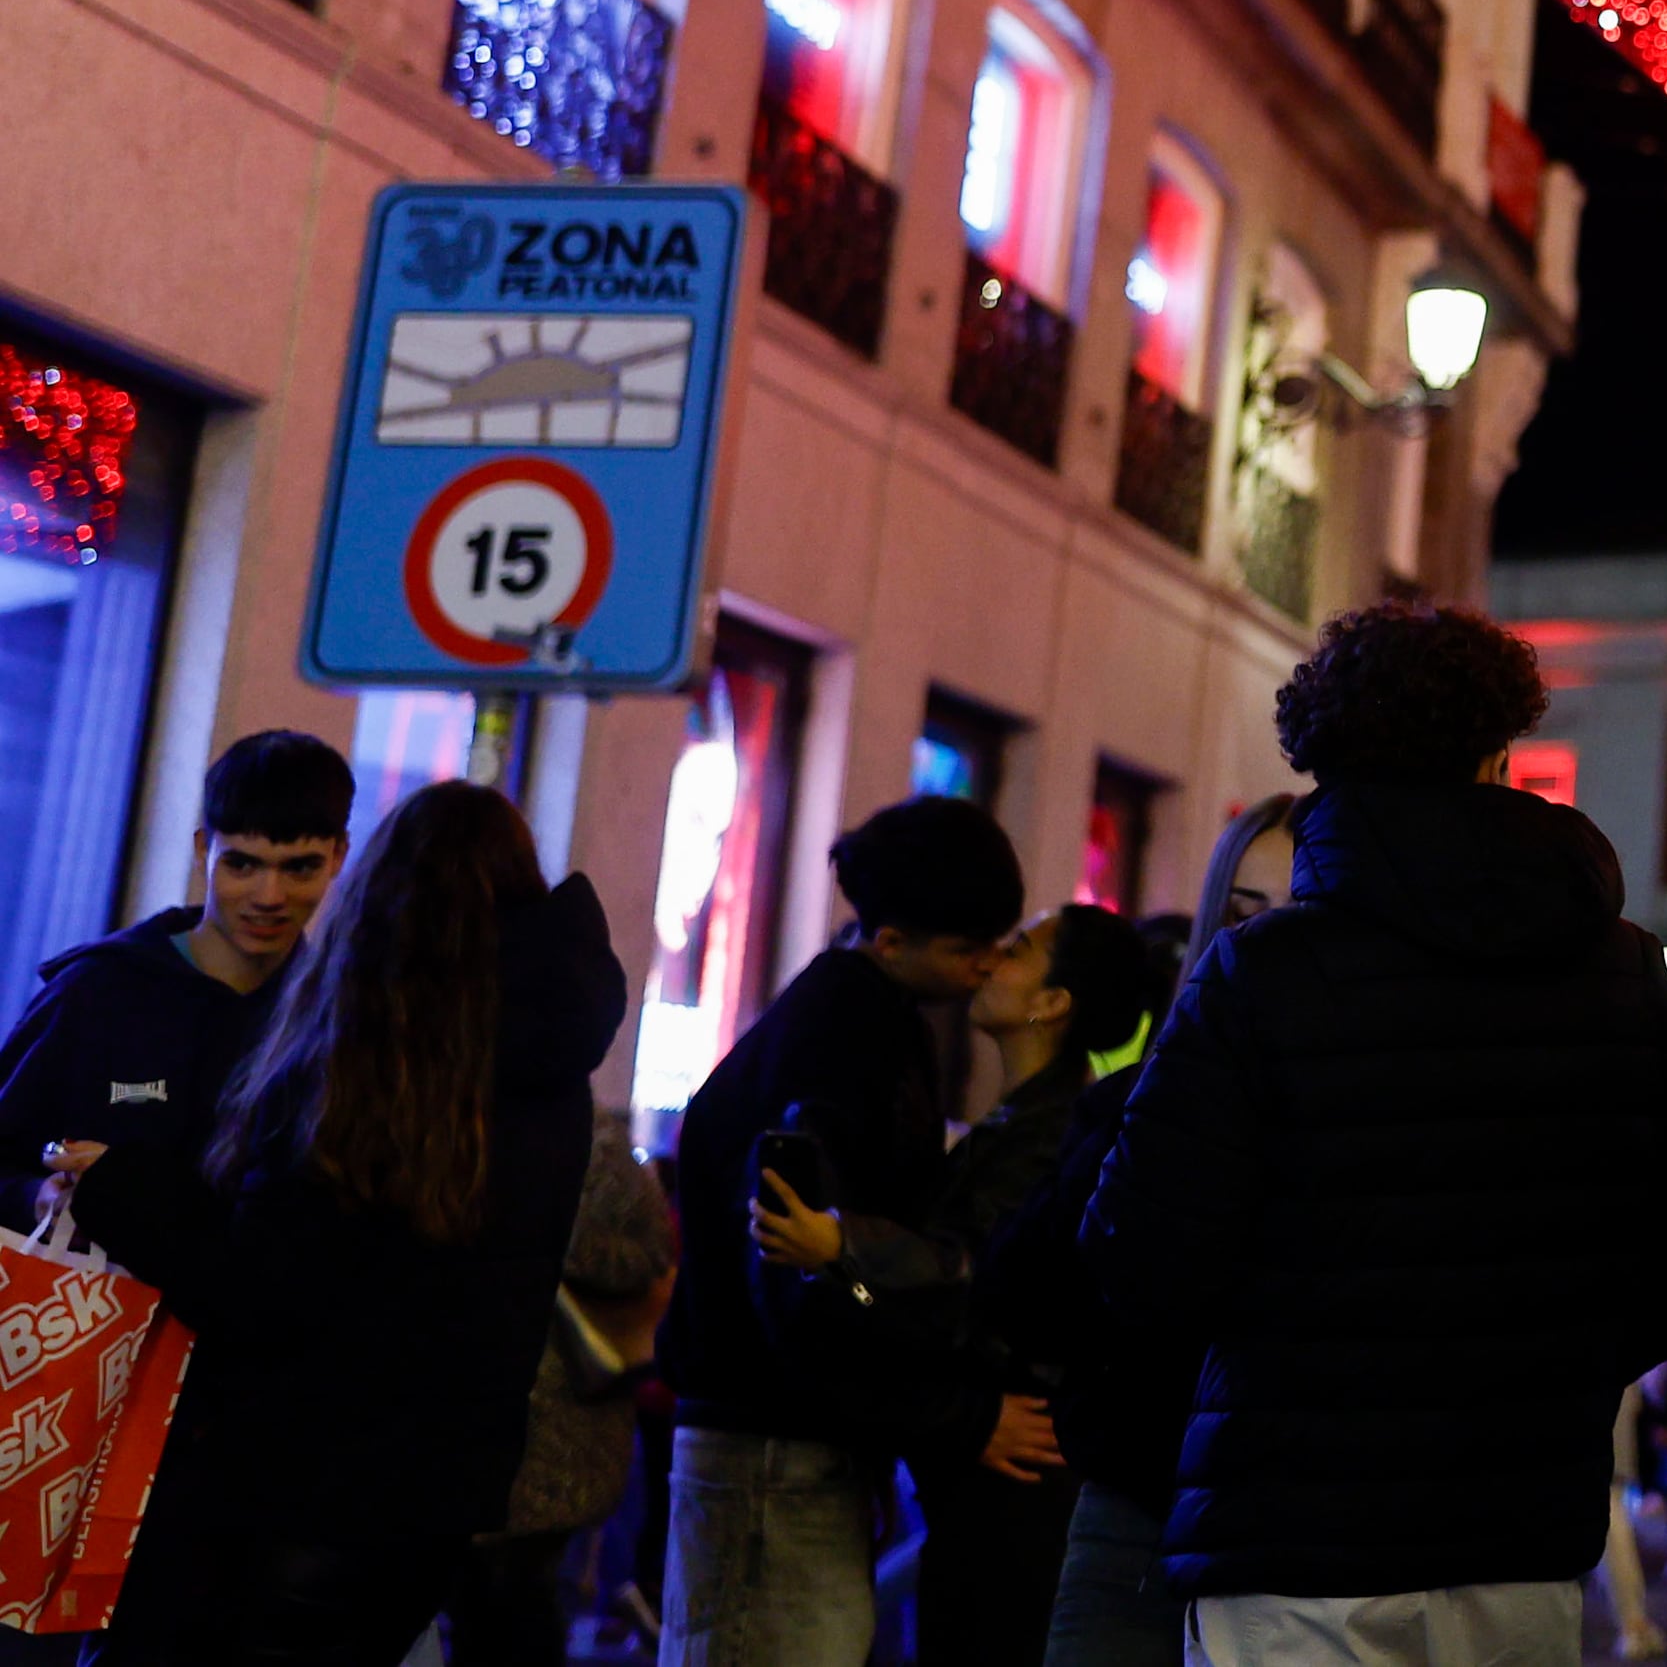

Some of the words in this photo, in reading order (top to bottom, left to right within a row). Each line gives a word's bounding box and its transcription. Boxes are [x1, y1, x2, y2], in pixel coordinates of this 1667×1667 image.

[505, 221, 699, 268] ZONA
[498, 273, 696, 302] PEATONAL
[466, 524, 552, 597] 15
